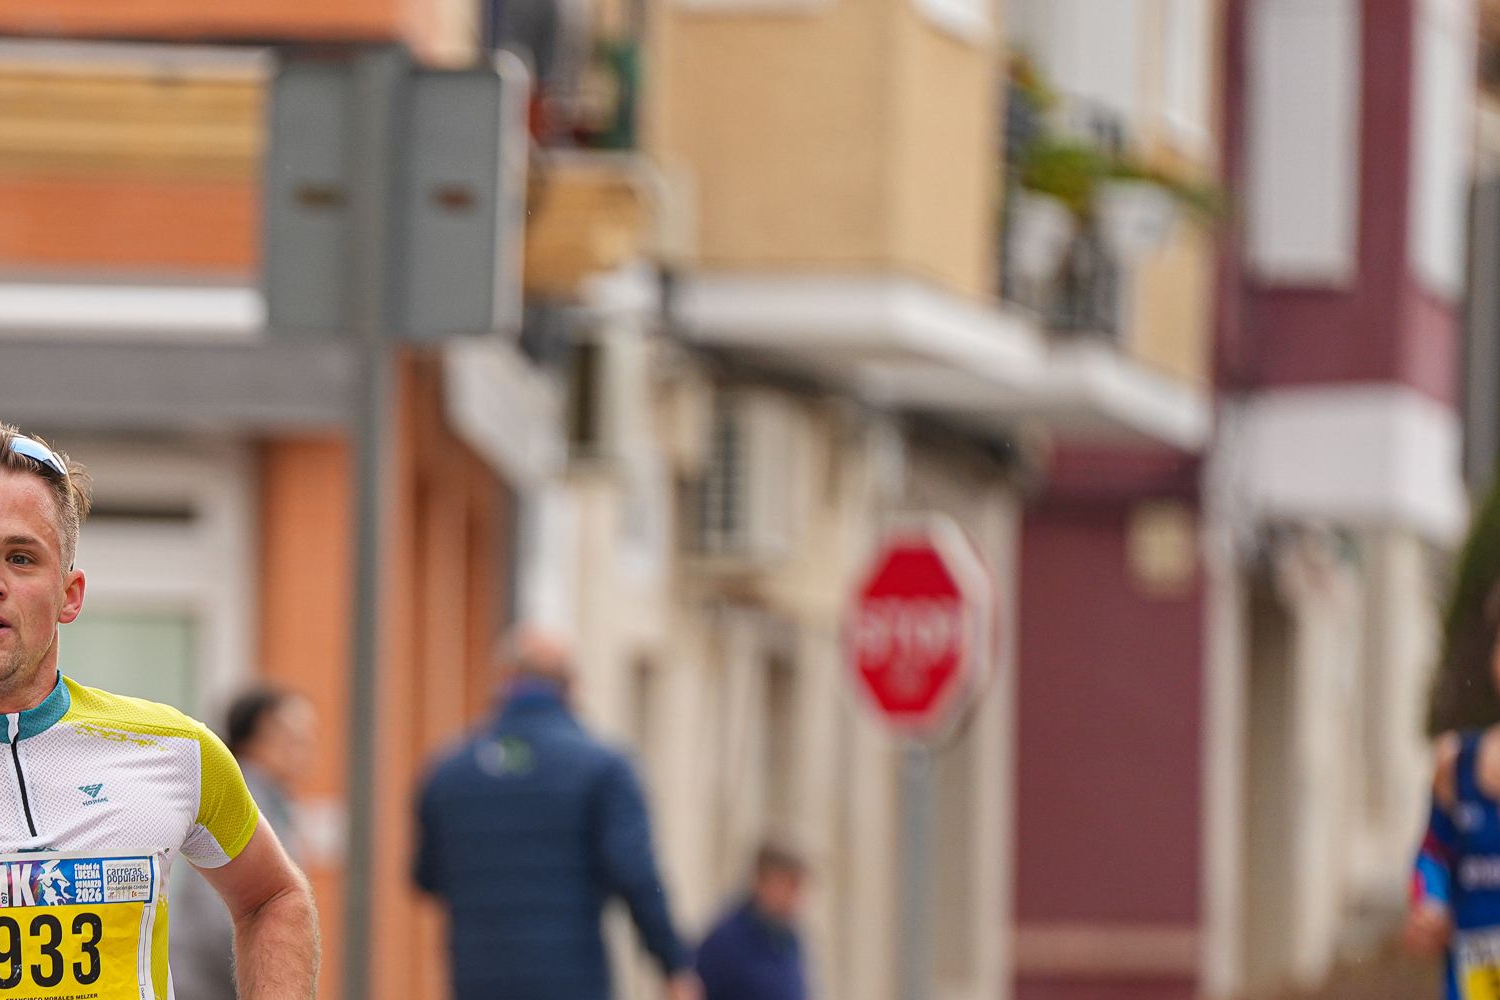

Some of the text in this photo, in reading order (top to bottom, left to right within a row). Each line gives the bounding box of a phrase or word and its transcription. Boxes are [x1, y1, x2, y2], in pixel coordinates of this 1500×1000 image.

[856, 598, 956, 664] STOP
[74, 863, 92, 871] Ciudad
[106, 867, 142, 876] carreras
[74, 869, 101, 880] LUCENA
[106, 873, 149, 885] populares
[83, 879, 102, 888] MARZO
[75, 888, 102, 903] 2026
